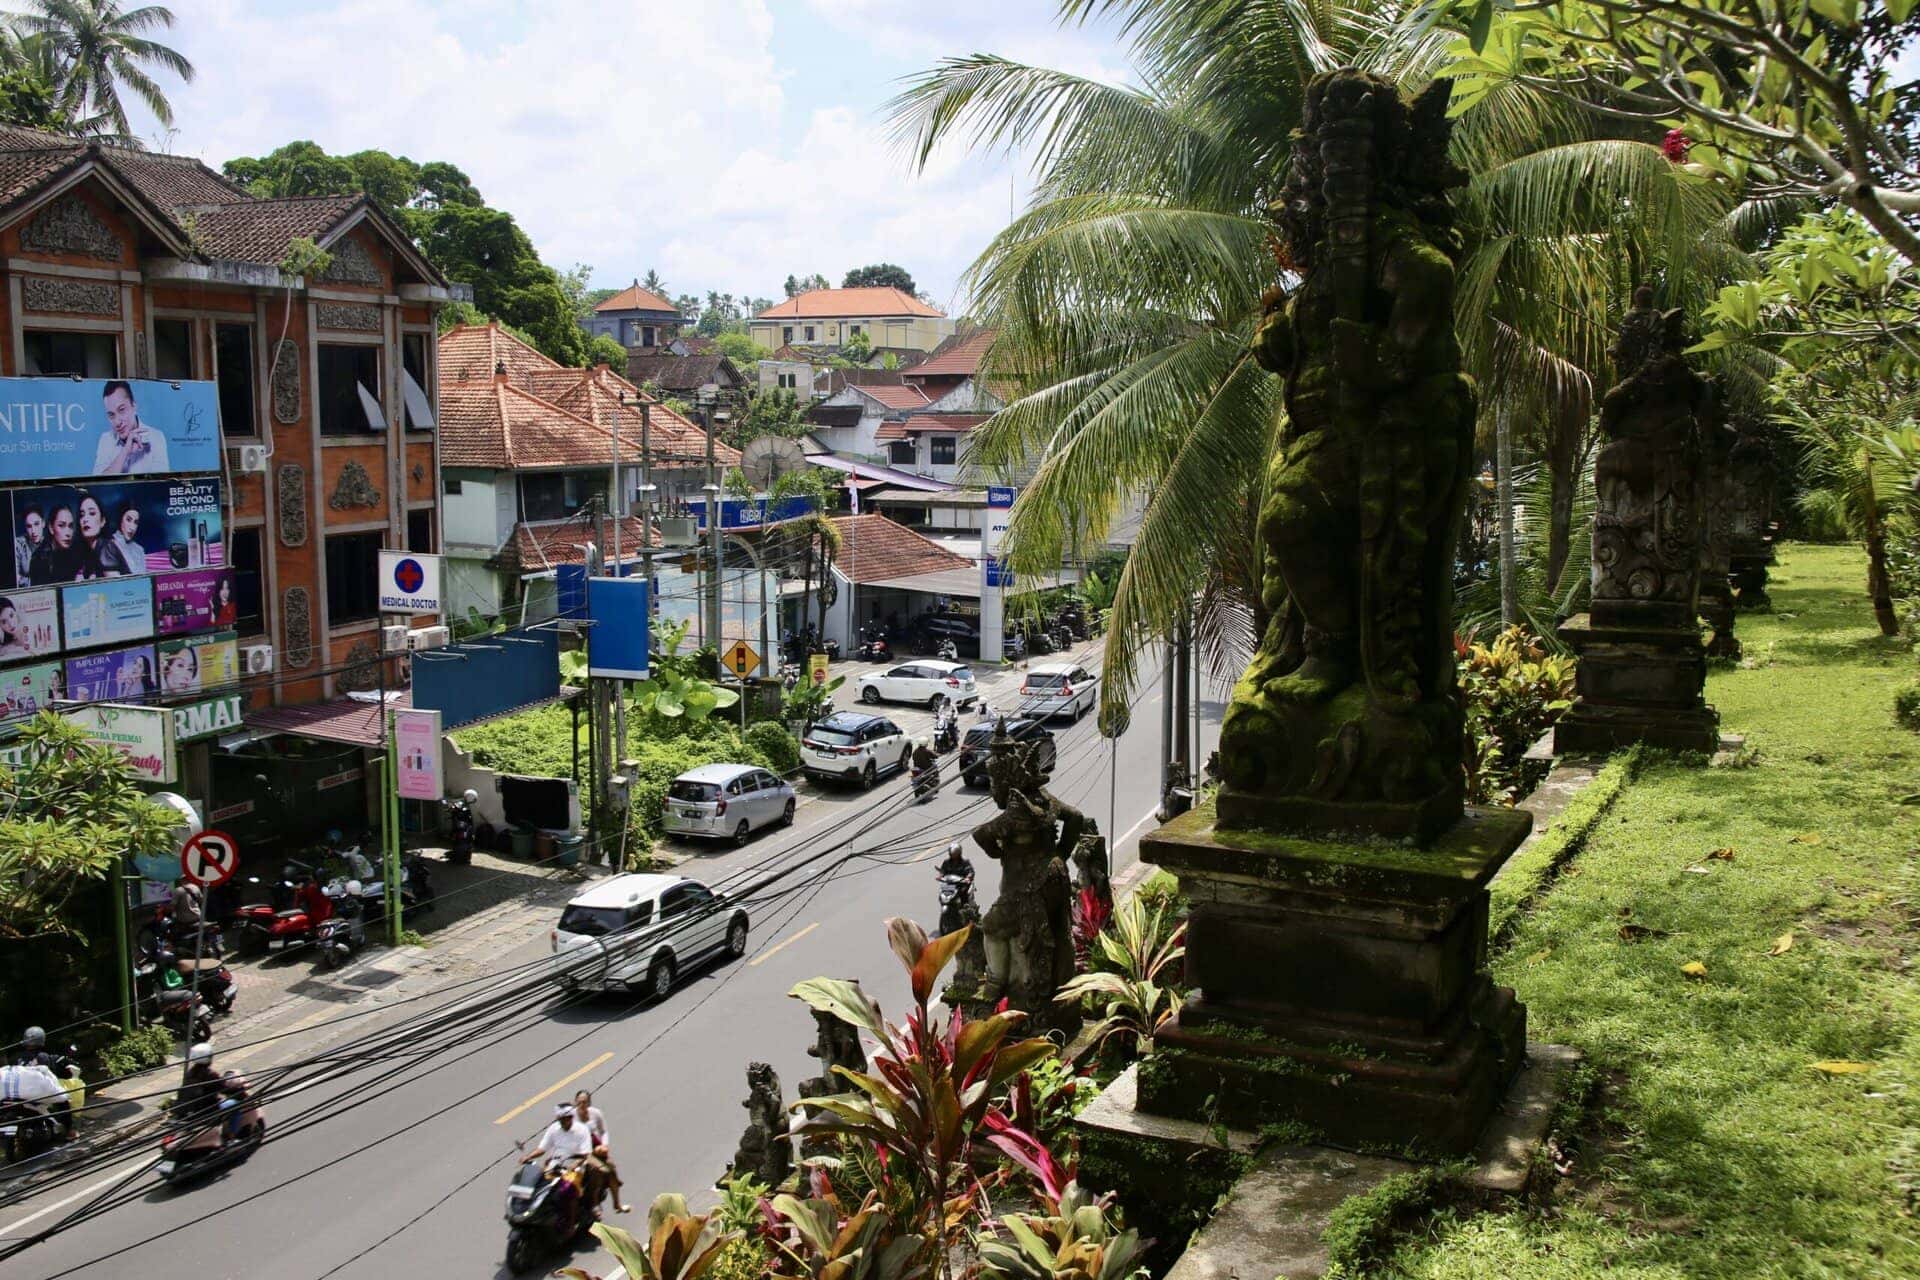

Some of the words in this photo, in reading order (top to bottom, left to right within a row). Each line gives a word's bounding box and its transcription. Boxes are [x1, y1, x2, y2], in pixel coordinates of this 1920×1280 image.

[169, 485, 213, 496] BEAUTY
[169, 495, 215, 506] BEYOND
[166, 504, 218, 516] COMPARE
[382, 596, 410, 608] MEDICAL
[411, 598, 437, 609] DOCTOR
[75, 655, 112, 669] IMPLORA
